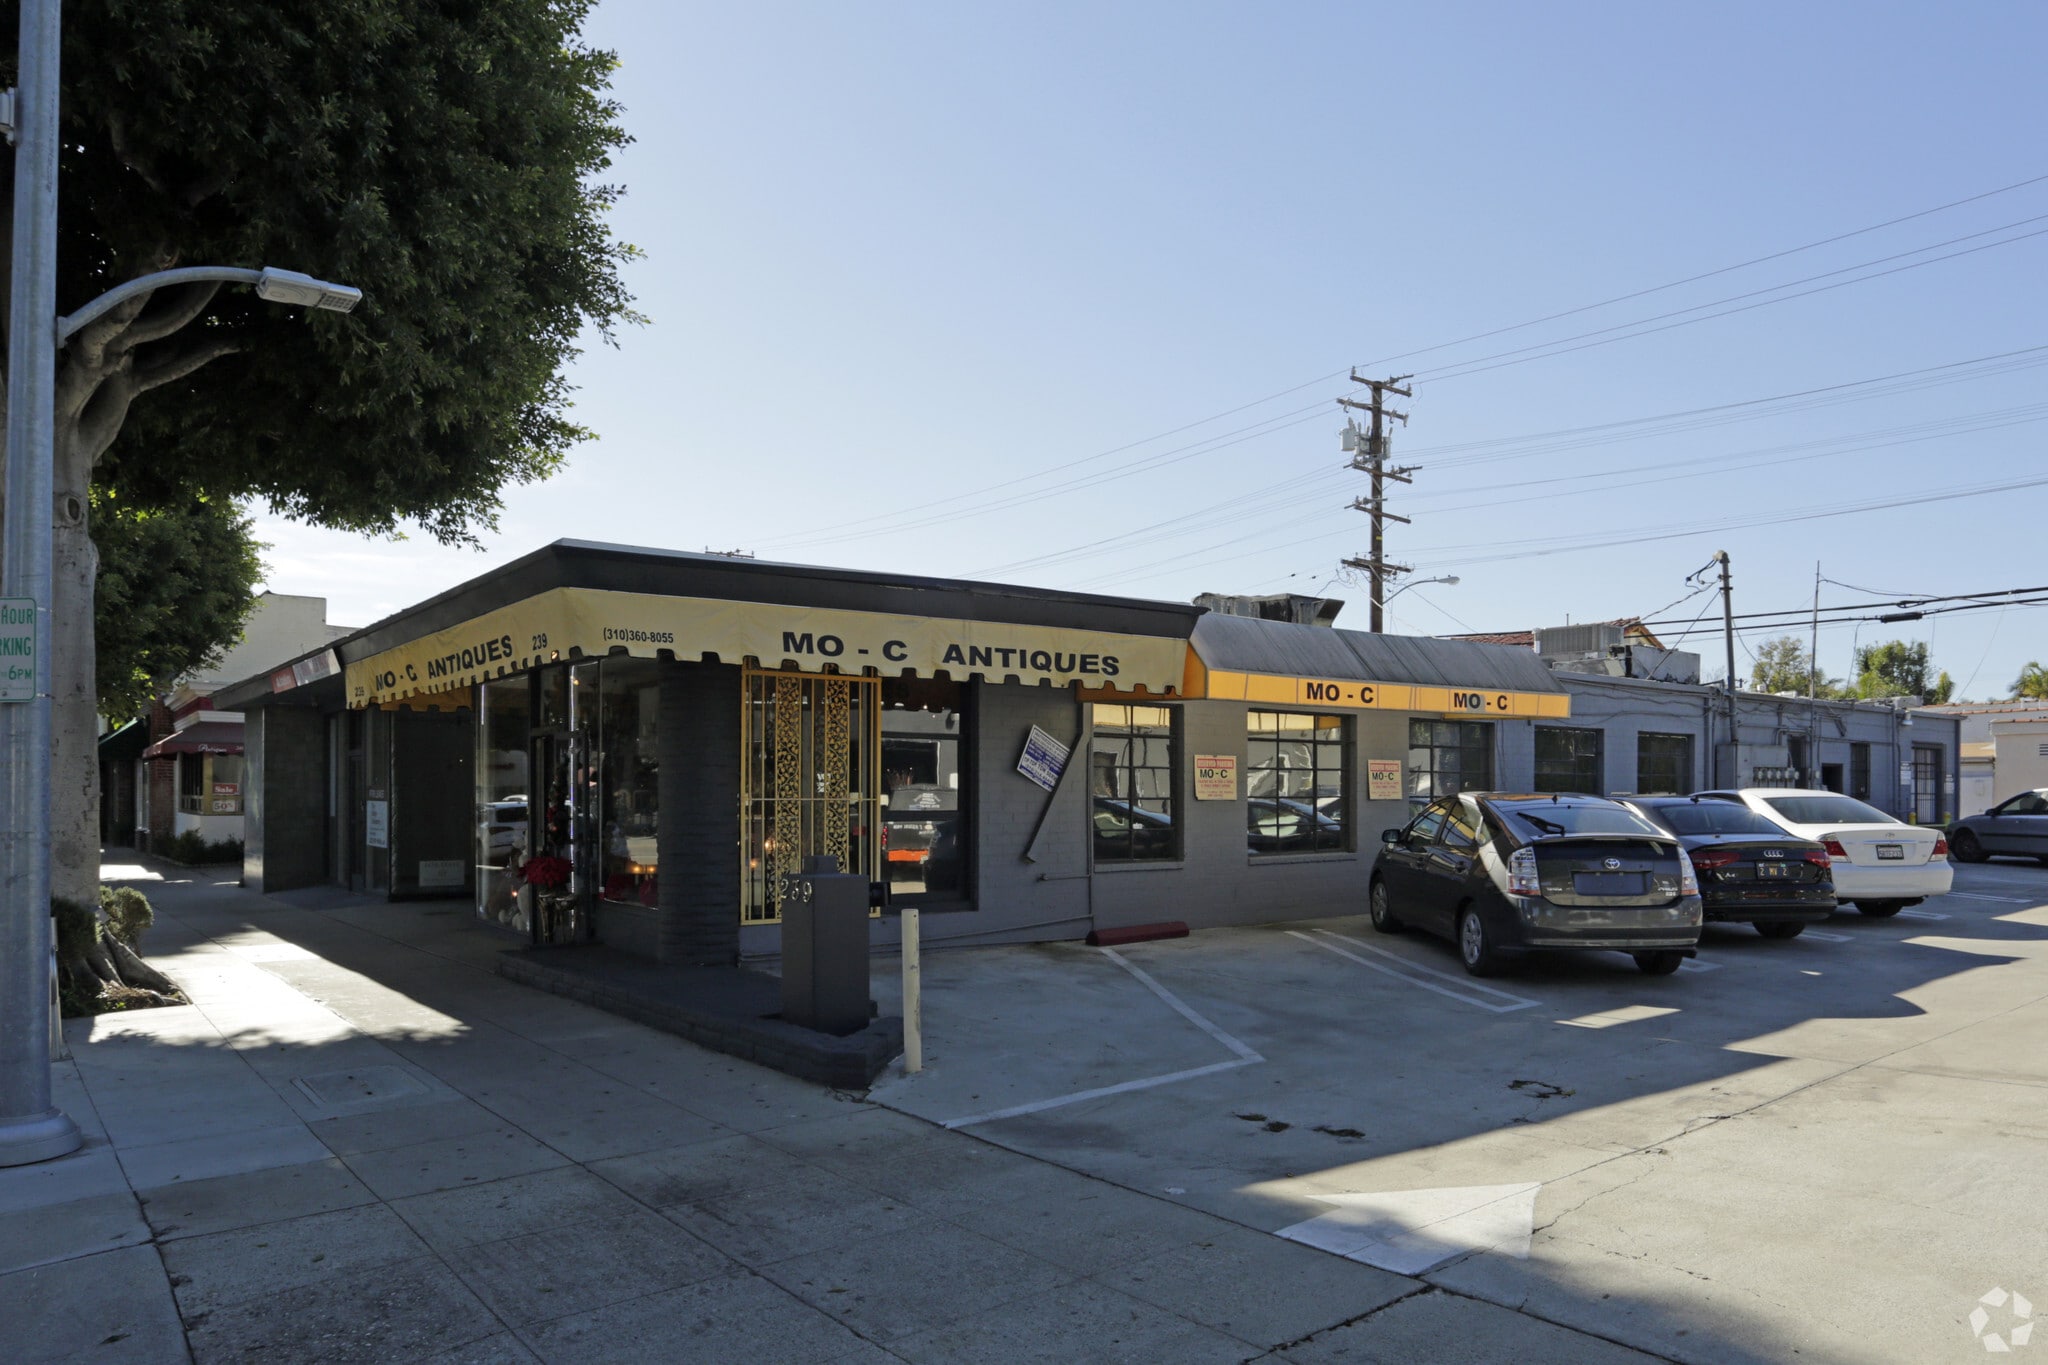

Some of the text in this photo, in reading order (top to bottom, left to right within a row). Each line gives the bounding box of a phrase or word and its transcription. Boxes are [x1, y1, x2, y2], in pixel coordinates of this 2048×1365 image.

[1, 609, 33, 624] HOUR
[532, 633, 548, 651] 239
[603, 627, 674, 643] (310)360-8055
[406, 664, 418, 682] C
[428, 635, 513, 680] ANTIQUES
[782, 631, 845, 658] MO
[882, 639, 909, 662] C
[943, 643, 1120, 676] ANTIQUES
[1306, 682, 1340, 701] MO
[1360, 687, 1375, 704] C
[1453, 692, 1481, 709] MO
[1496, 695, 1508, 711] C
[779, 878, 813, 903] 239
